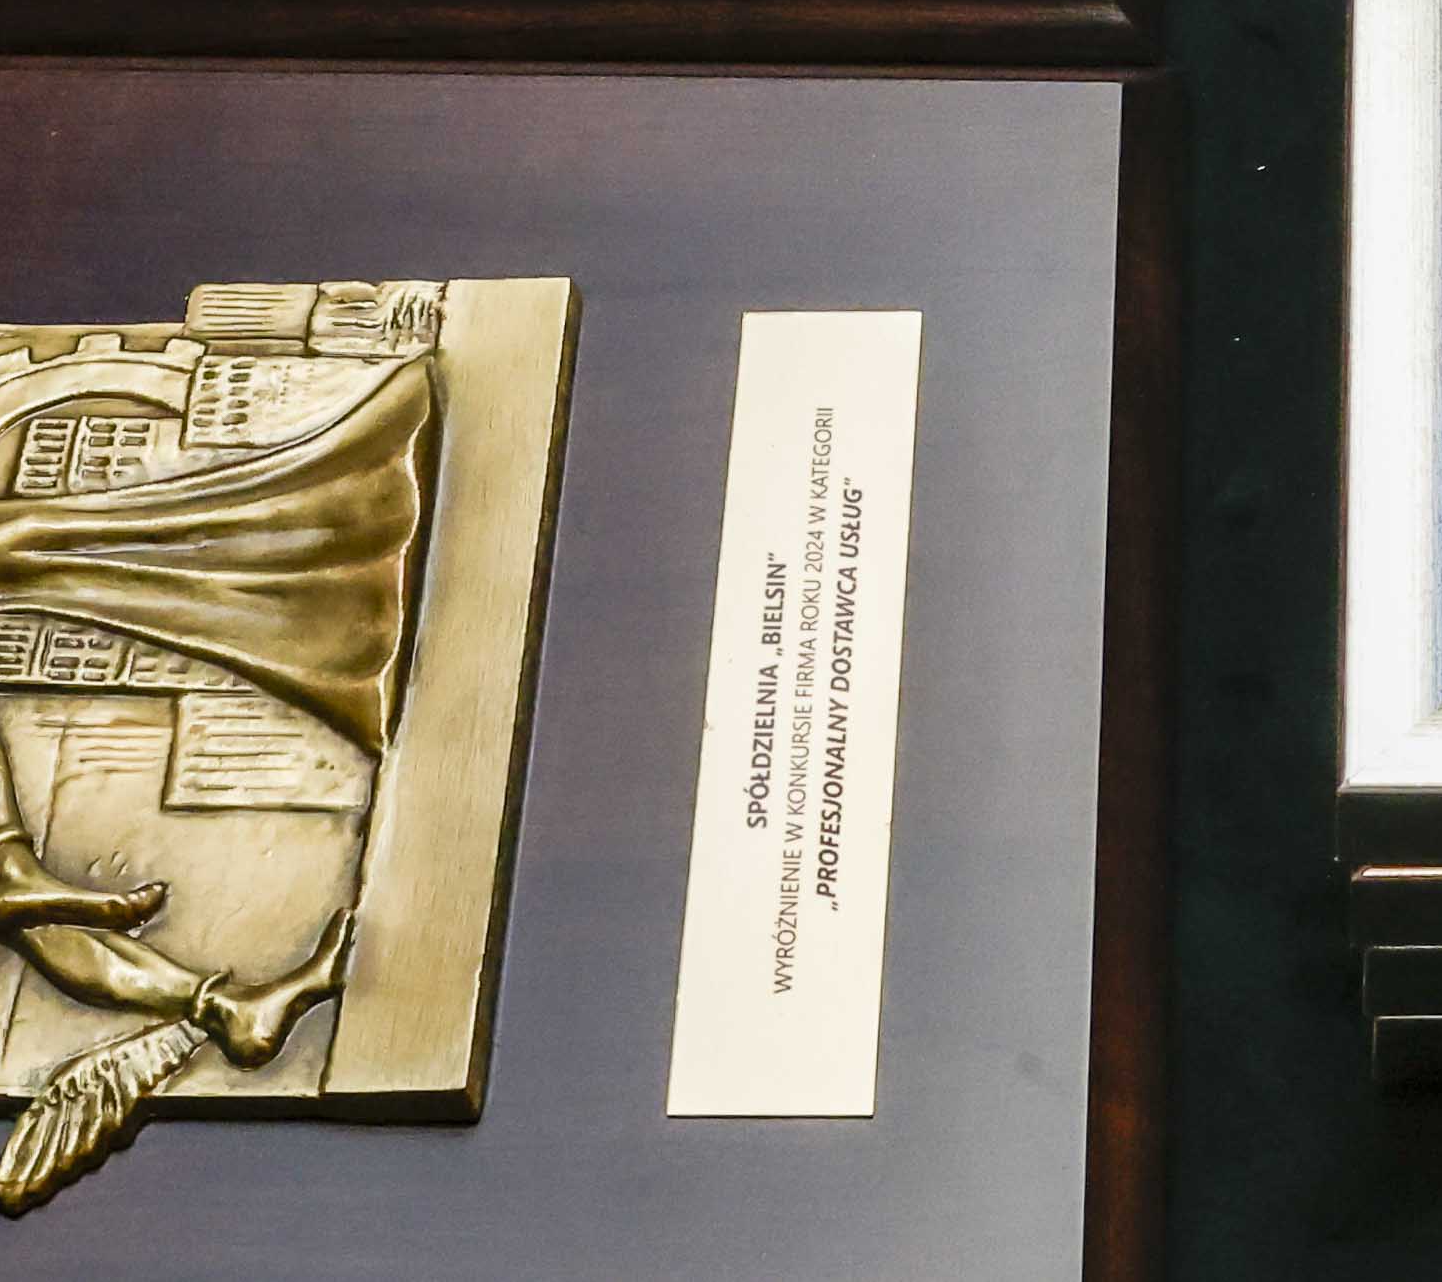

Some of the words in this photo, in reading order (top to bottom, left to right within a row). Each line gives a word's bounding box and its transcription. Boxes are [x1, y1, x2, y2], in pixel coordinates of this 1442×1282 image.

[810, 407, 834, 500] KATEGORII
[803, 530, 825, 573] 2024
[807, 505, 827, 525] W
[799, 579, 822, 632] ROKU
[829, 566, 858, 693] DOSTAWCA
[794, 637, 818, 698] FIRMA
[742, 664, 779, 829] SPÓŁDZIELNIA
[786, 704, 813, 816] KONKURSIE
[784, 821, 804, 843] W
[773, 849, 803, 994] WYRÓŻNIENIE
